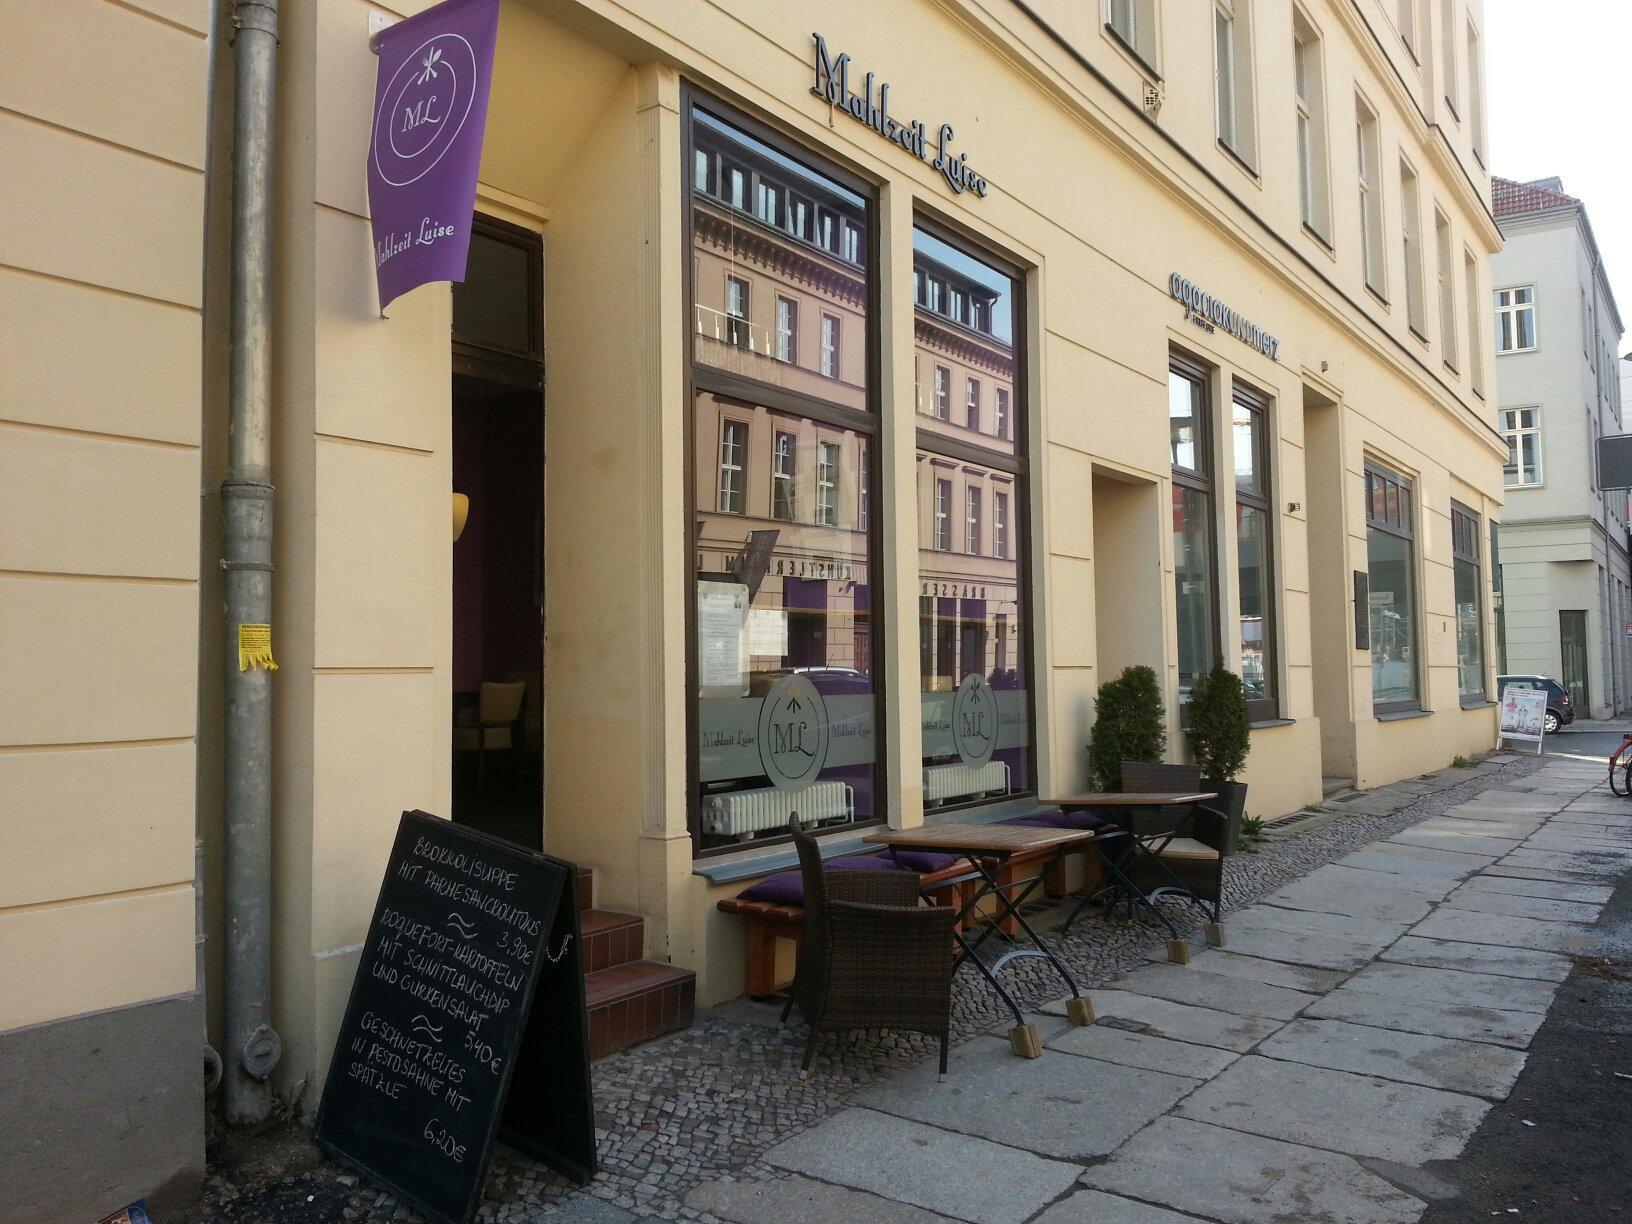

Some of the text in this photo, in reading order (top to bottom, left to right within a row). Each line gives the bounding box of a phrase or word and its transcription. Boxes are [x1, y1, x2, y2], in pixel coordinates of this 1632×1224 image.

[401, 95, 441, 133] ML
[809, 32, 988, 198] Mahlzeit Luise
[415, 217, 454, 245] Luise
[773, 721, 815, 757] ML
[377, 935, 403, 960] MIT
[372, 961, 398, 984] UND
[351, 1037, 367, 1054] IN
[444, 1088, 472, 1112] MIT
